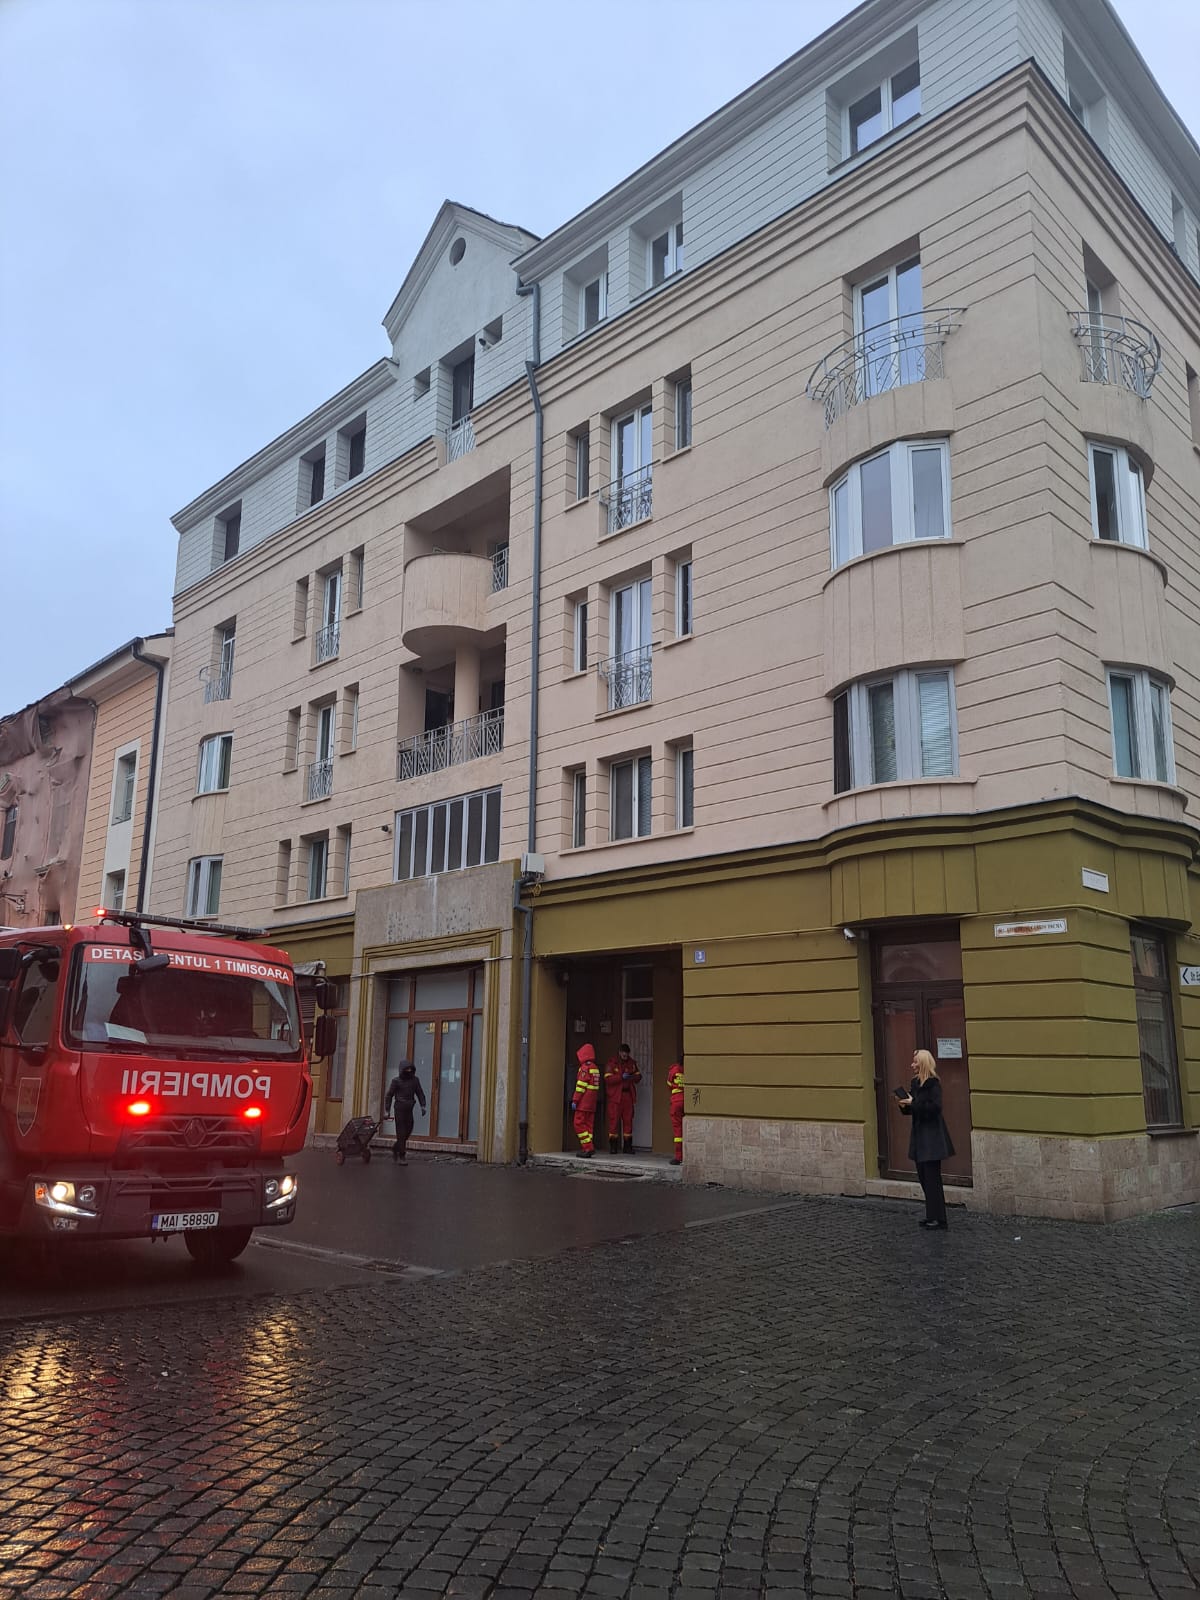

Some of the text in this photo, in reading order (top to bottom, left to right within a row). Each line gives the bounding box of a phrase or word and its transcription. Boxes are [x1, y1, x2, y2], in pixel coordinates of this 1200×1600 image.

[91, 948, 289, 981] DETASENTUL 1 TIMISOARA
[161, 1215, 179, 1228] MAI
[182, 1213, 216, 1226] 58890
